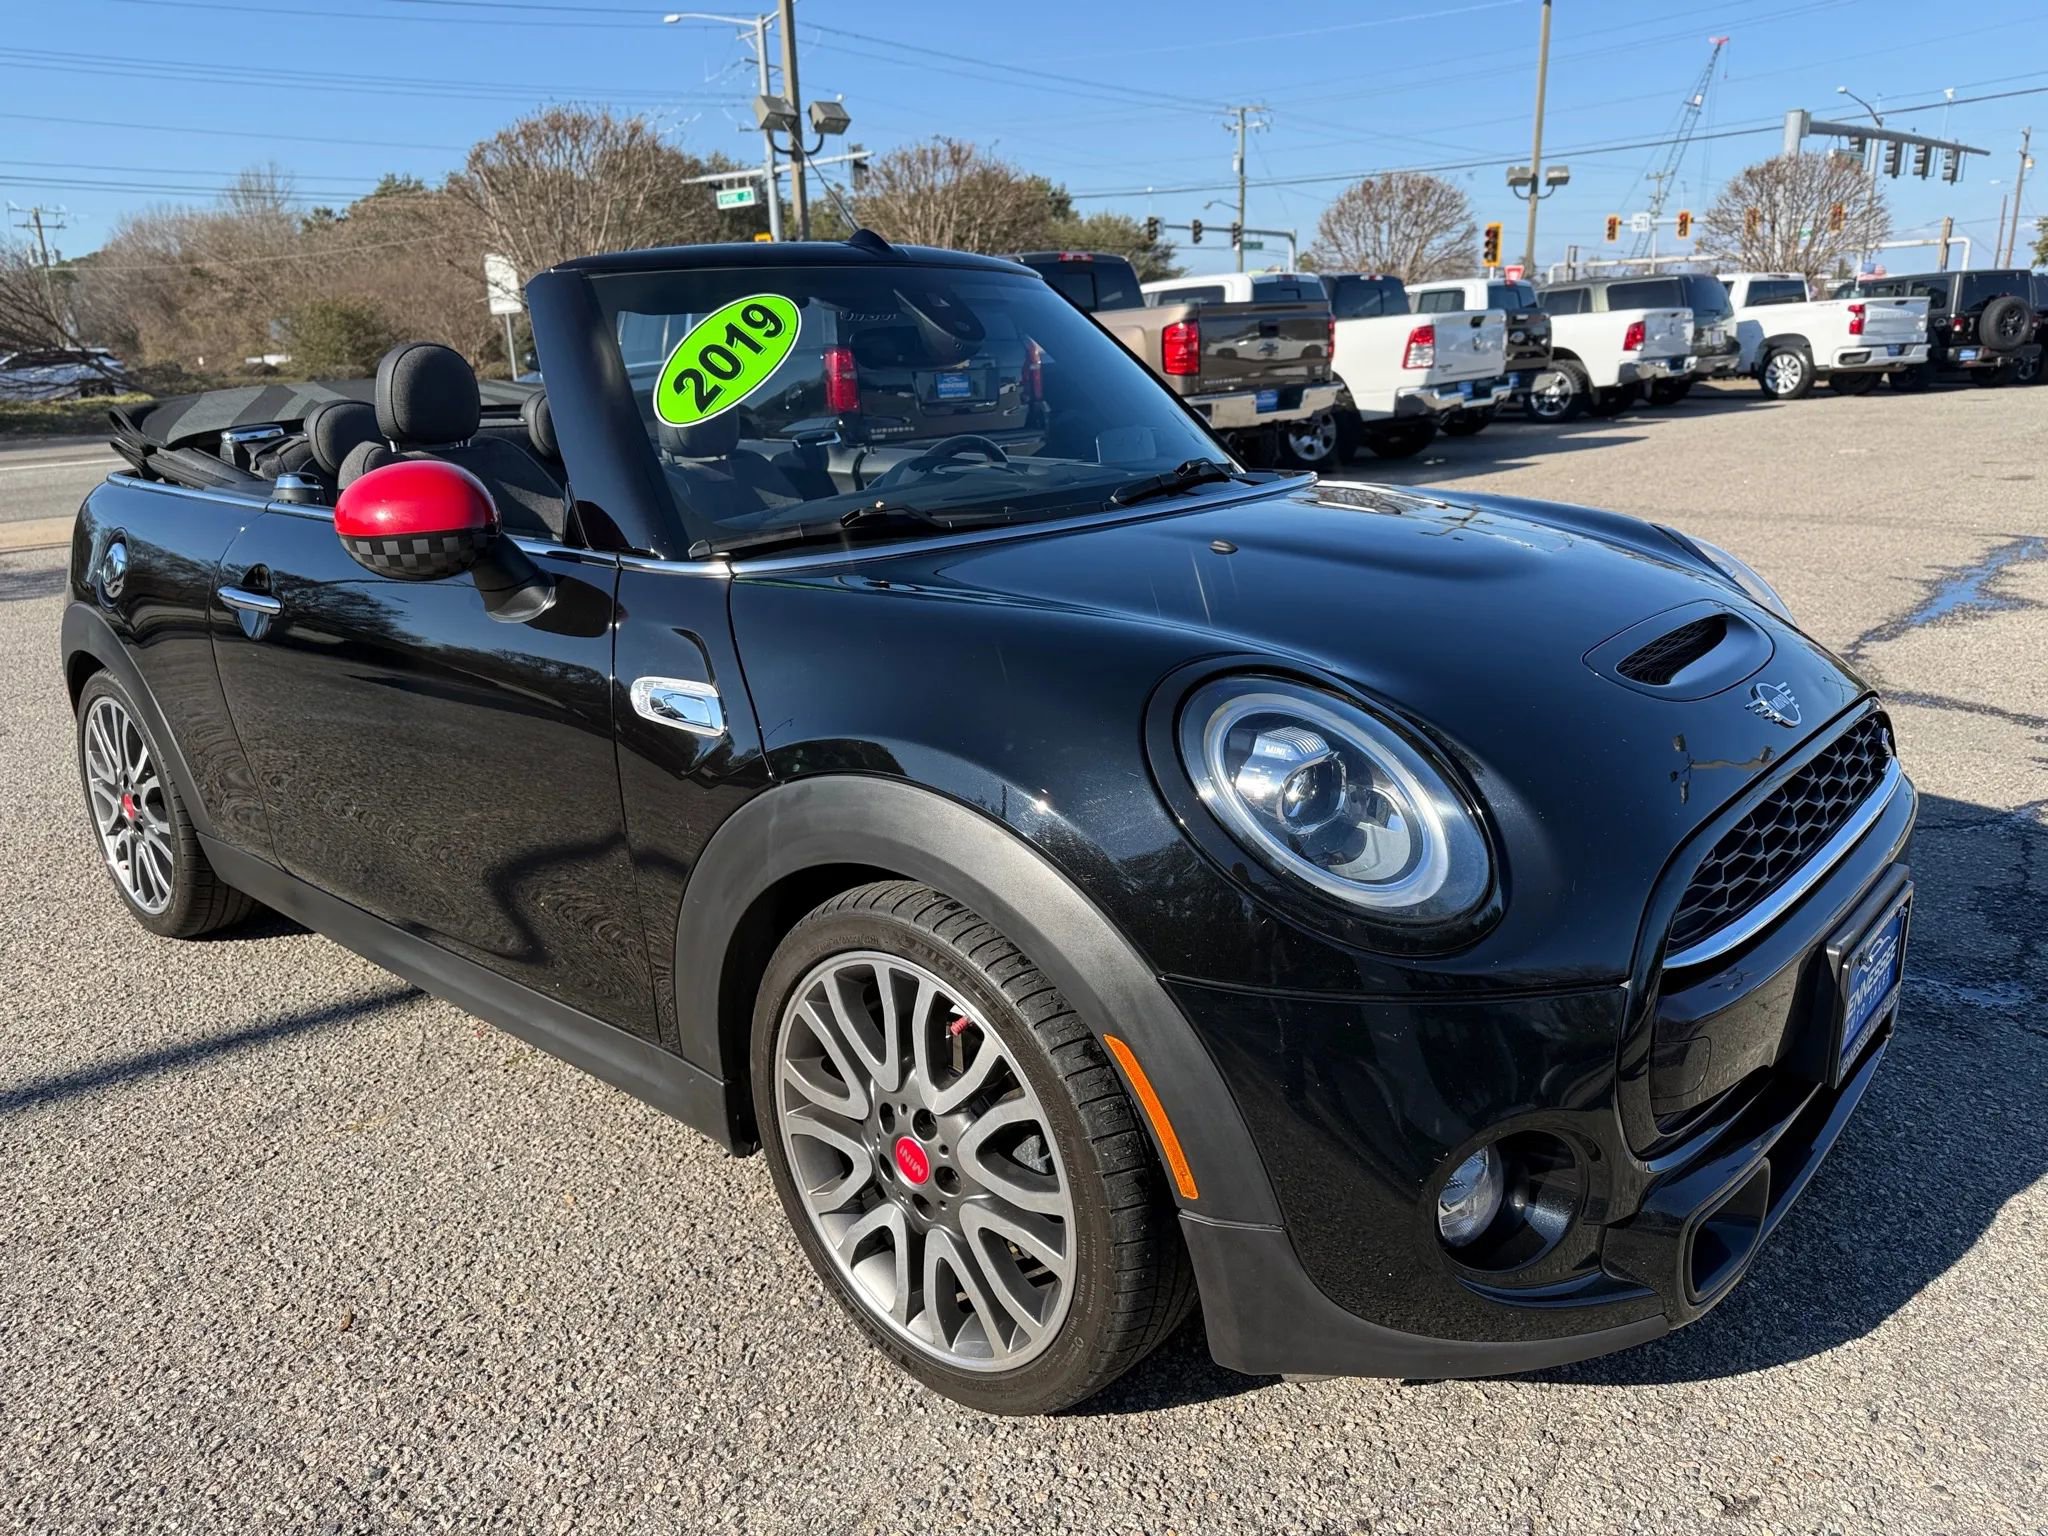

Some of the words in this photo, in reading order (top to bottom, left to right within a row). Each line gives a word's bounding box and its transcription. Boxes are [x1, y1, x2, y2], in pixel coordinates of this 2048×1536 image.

[673, 303, 786, 414] 2019
[1264, 744, 1286, 757] MINI
[1868, 967, 1891, 1005] SALES
[899, 1145, 924, 1177] MINI
